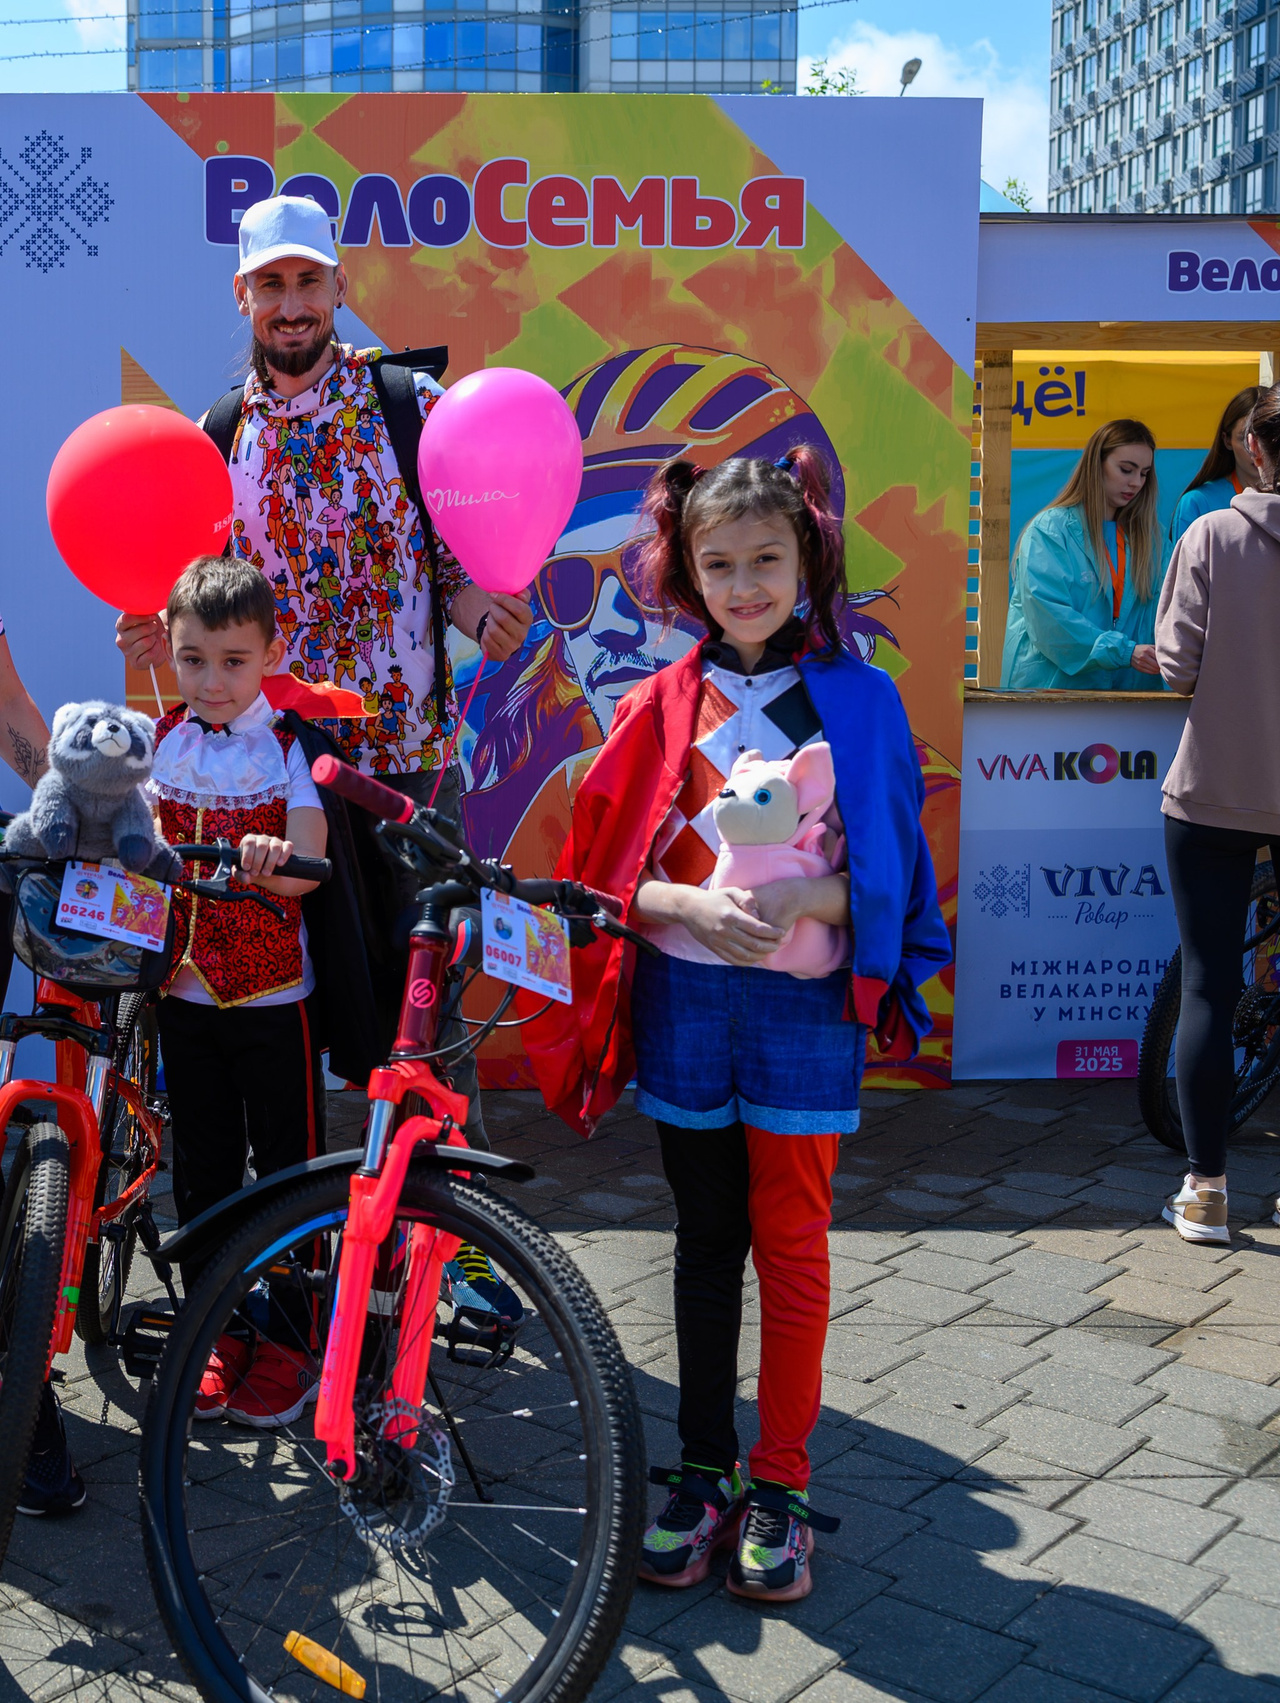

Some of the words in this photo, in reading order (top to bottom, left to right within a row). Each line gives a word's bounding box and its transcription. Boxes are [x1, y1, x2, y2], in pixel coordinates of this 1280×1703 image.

[1168, 251, 1280, 292] Вело
[977, 754, 1049, 781] VIVA
[1053, 743, 1158, 784] KOLA
[1039, 863, 1166, 897] VIVA
[61, 903, 105, 922] 06246
[1075, 902, 1129, 929] Ровар
[485, 945, 522, 967] 06007
[1033, 1006, 1046, 1021] У
[1075, 1046, 1088, 1057] 31
[1093, 1046, 1119, 1057] МАЯ
[1075, 1057, 1123, 1072] 2025
